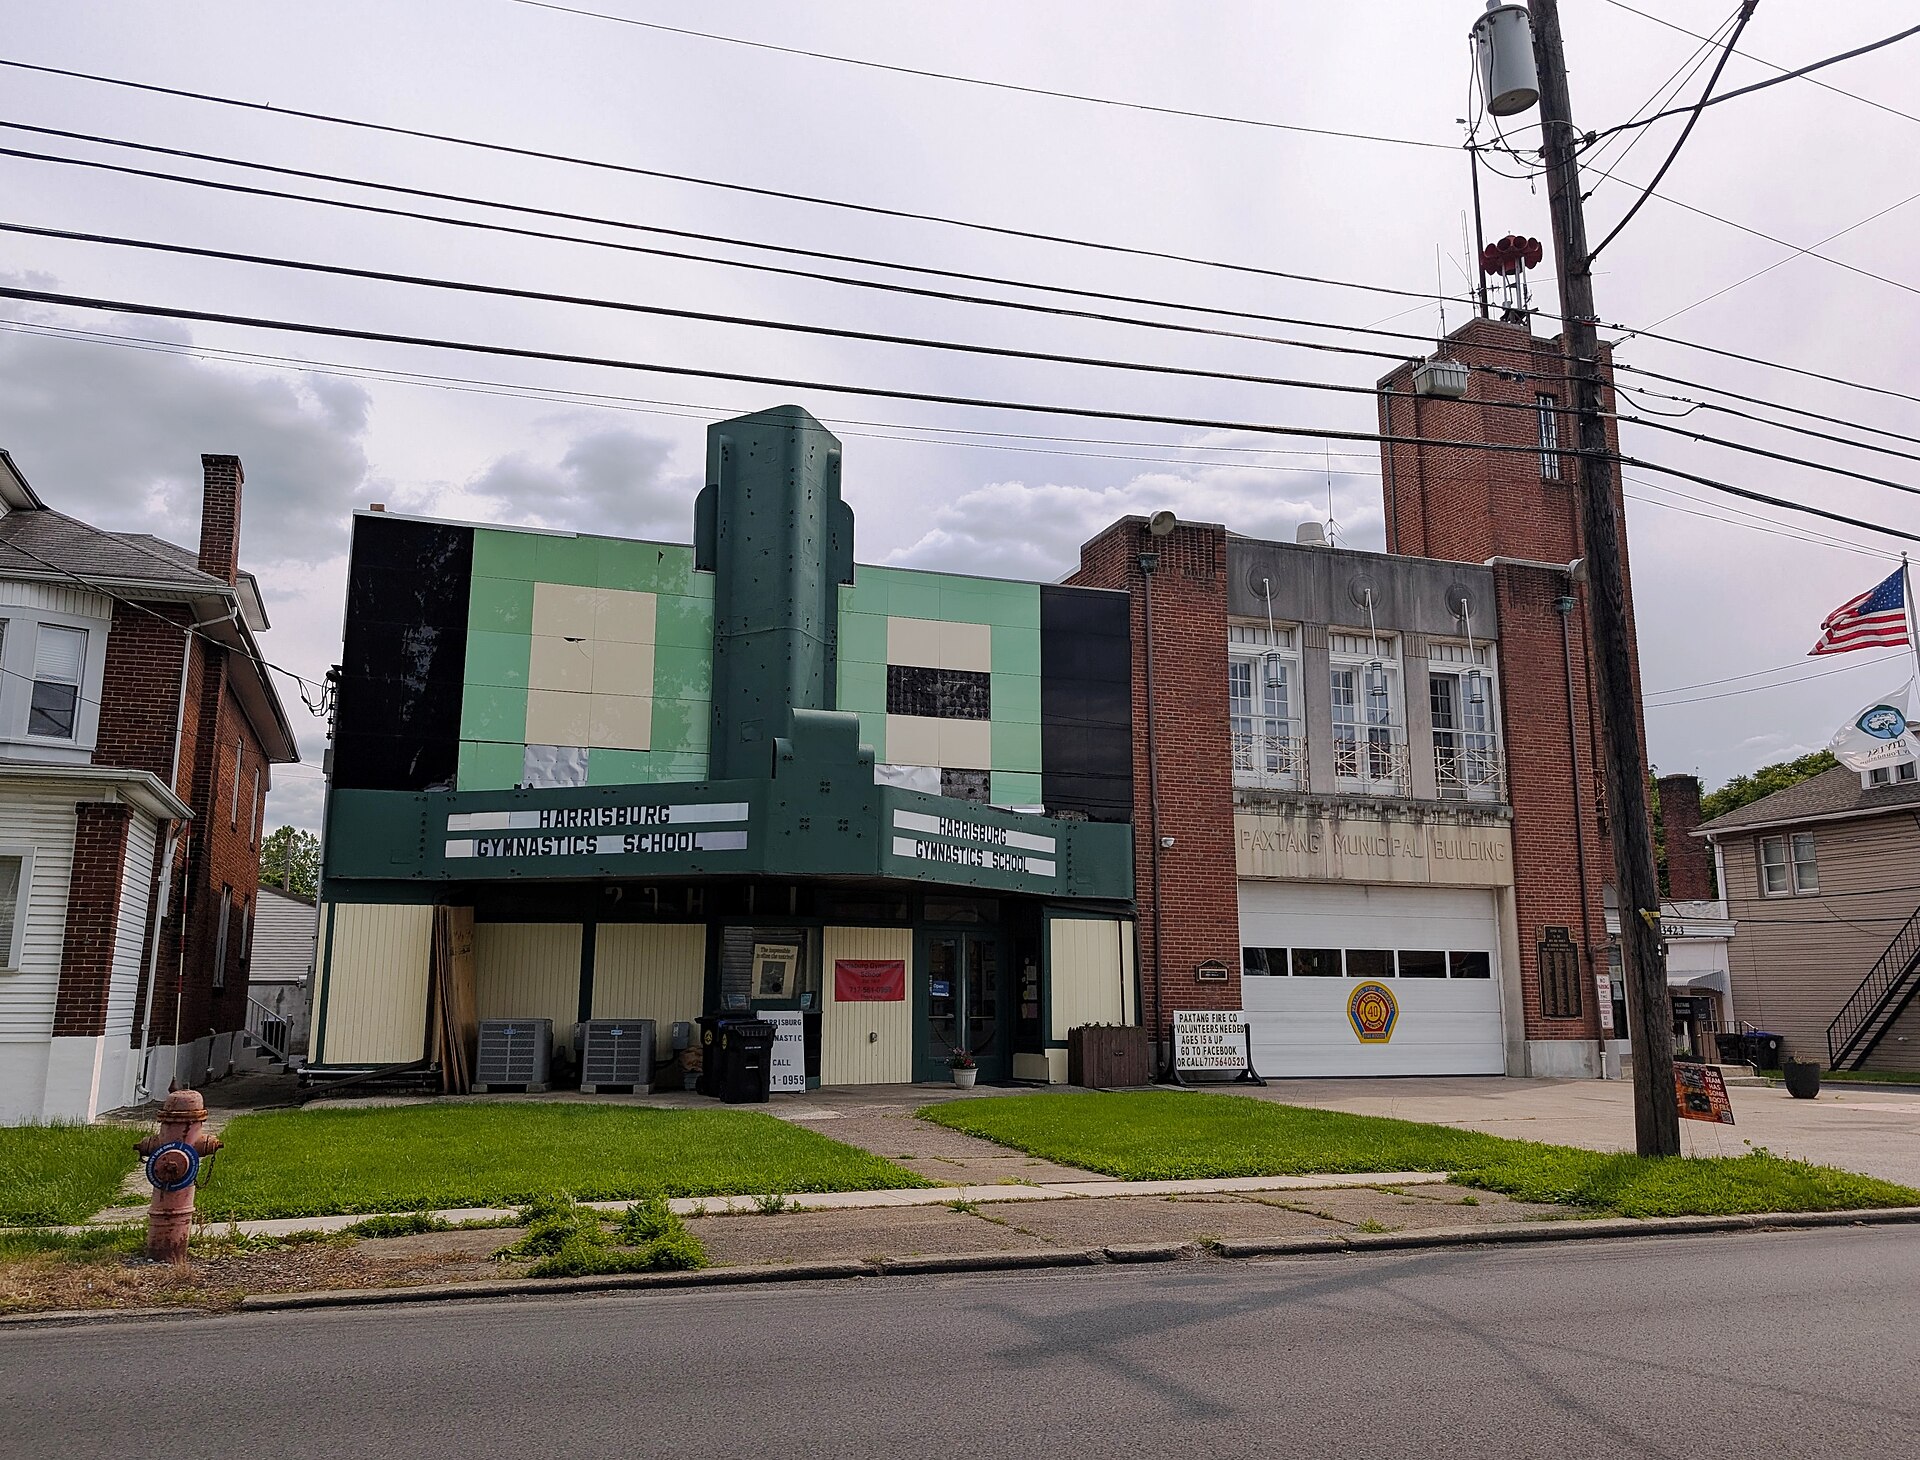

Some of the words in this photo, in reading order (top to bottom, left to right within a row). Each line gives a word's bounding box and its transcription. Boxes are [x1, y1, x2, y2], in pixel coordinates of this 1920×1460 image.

[540, 804, 670, 828] HARRISBURG
[939, 817, 1007, 846] HARRISBURG
[477, 835, 598, 858] GYMNASTICS
[623, 832, 703, 854] SCHOOL
[1240, 829, 1320, 854] PAXTANG
[1333, 834, 1424, 859] MUNICIPAL
[1434, 839, 1505, 862] BUILDING
[915, 840, 983, 867] GYMNASTICS
[992, 853, 1030, 873] SCHOOL
[1661, 925, 1685, 936] 3423
[1367, 1005, 1379, 1017] 40
[1179, 1013, 1209, 1022] PAXTANG
[1211, 1013, 1226, 1022] FIRE
[1228, 1013, 1238, 1022] CO
[1176, 1024, 1218, 1033] VOLUNTEERS
[1220, 1024, 1244, 1033] NEEDED
[775, 1034, 802, 1042] NASTIC
[1181, 1035, 1198, 1044] AGES
[1200, 1035, 1207, 1044] 15
[1208, 1036, 1213, 1044] &
[1214, 1035, 1223, 1044] UP
[1180, 1046, 1190, 1055] GO
[1192, 1046, 1201, 1055] TO
[1203, 1046, 1237, 1055] FACEBOOK
[1177, 1057, 1185, 1067] OR
[1186, 1057, 1203, 1067] CALL
[1204, 1057, 1245, 1067] 7175640520
[1708, 1090, 1725, 1098] SOME
